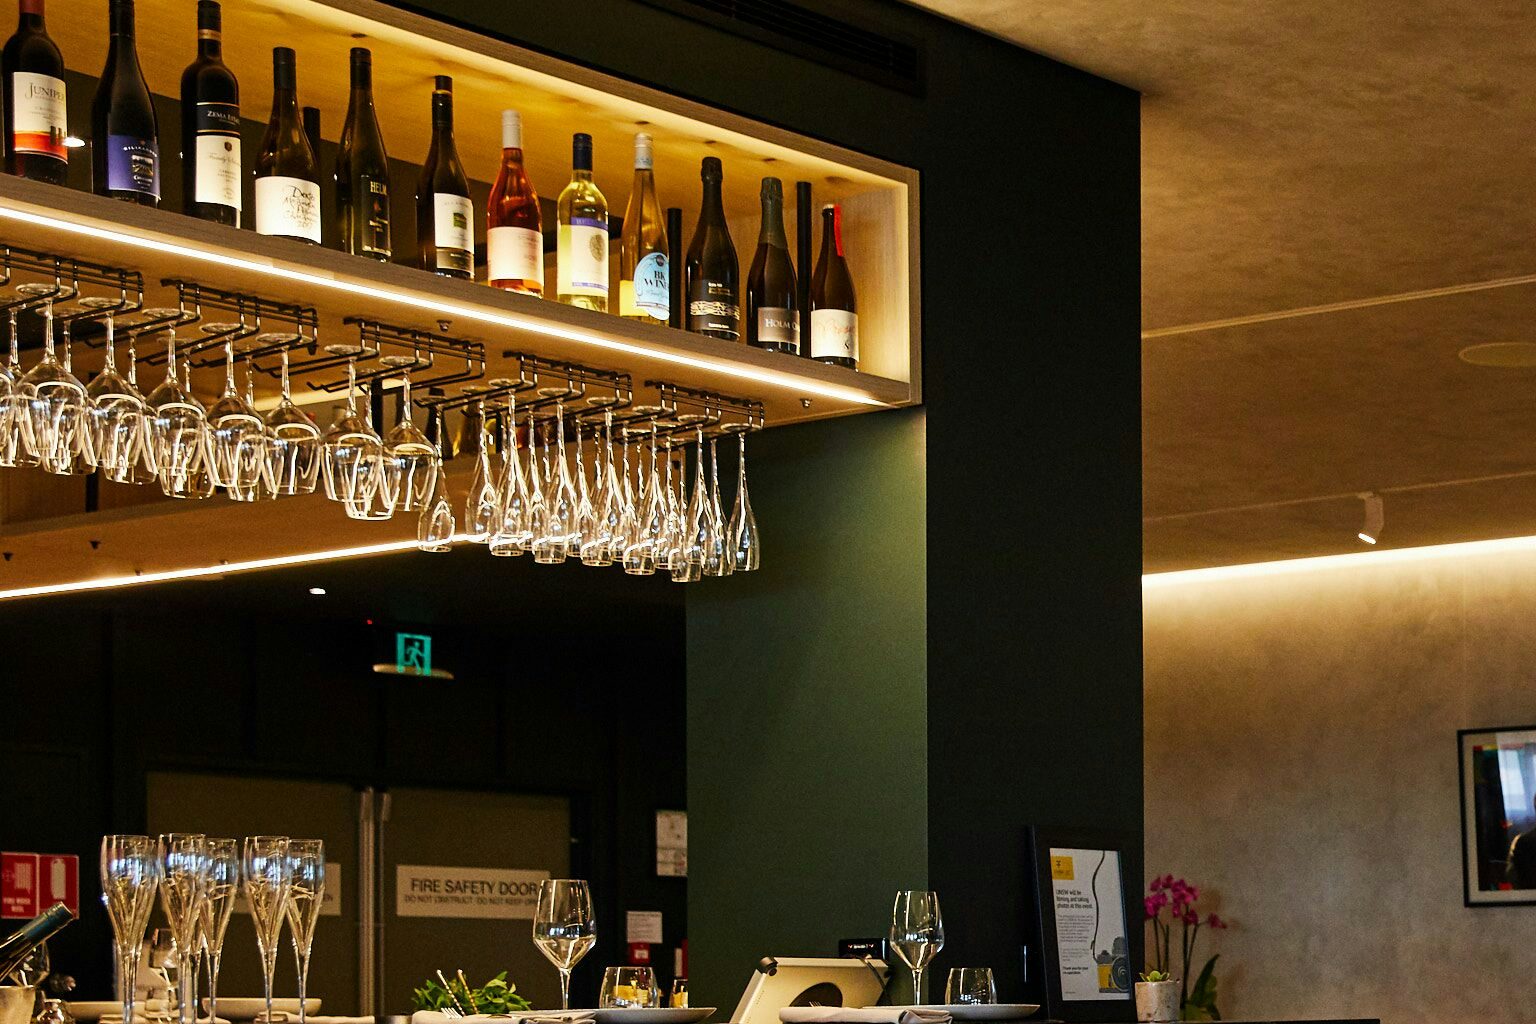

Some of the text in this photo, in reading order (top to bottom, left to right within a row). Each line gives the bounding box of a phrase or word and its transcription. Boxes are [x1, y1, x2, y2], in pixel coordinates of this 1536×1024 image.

[411, 878, 538, 896] FIRE SAFETY DOOR
